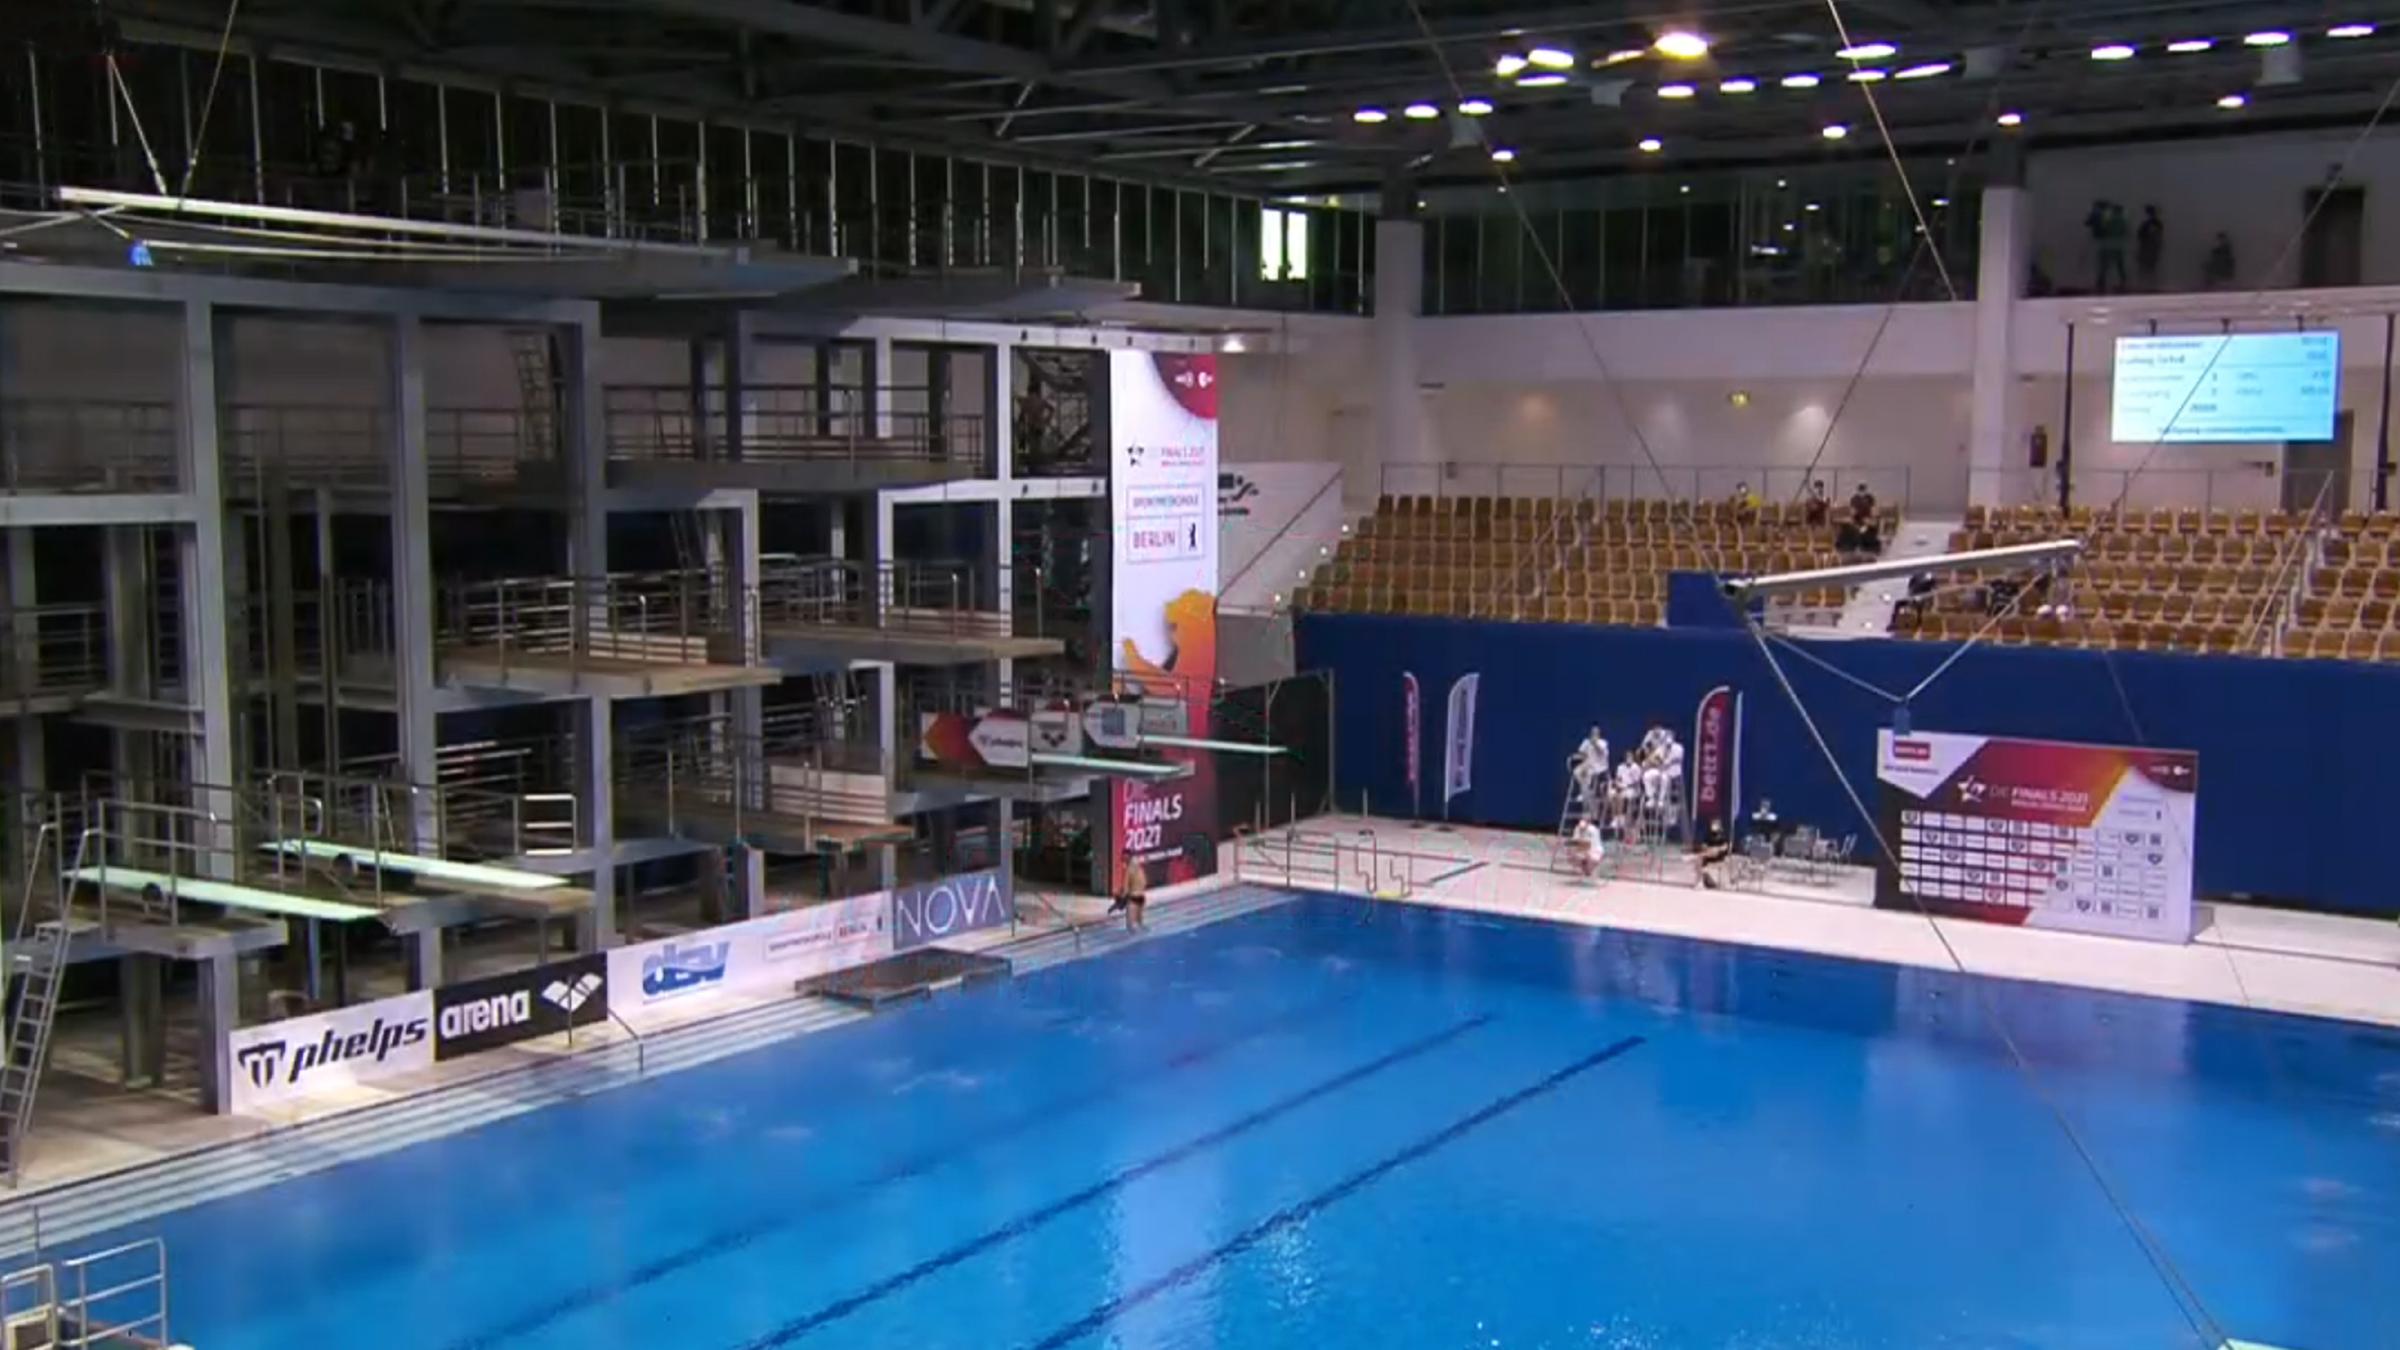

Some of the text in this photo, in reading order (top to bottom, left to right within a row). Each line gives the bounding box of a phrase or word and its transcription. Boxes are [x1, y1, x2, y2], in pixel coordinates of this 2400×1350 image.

[1133, 530, 1176, 549] BERLIN
[1123, 793, 1182, 828] FINALS
[1125, 823, 1161, 851] 2021
[897, 875, 1005, 942] NOVA
[439, 989, 531, 1040] arena
[287, 1016, 429, 1084] phelps
